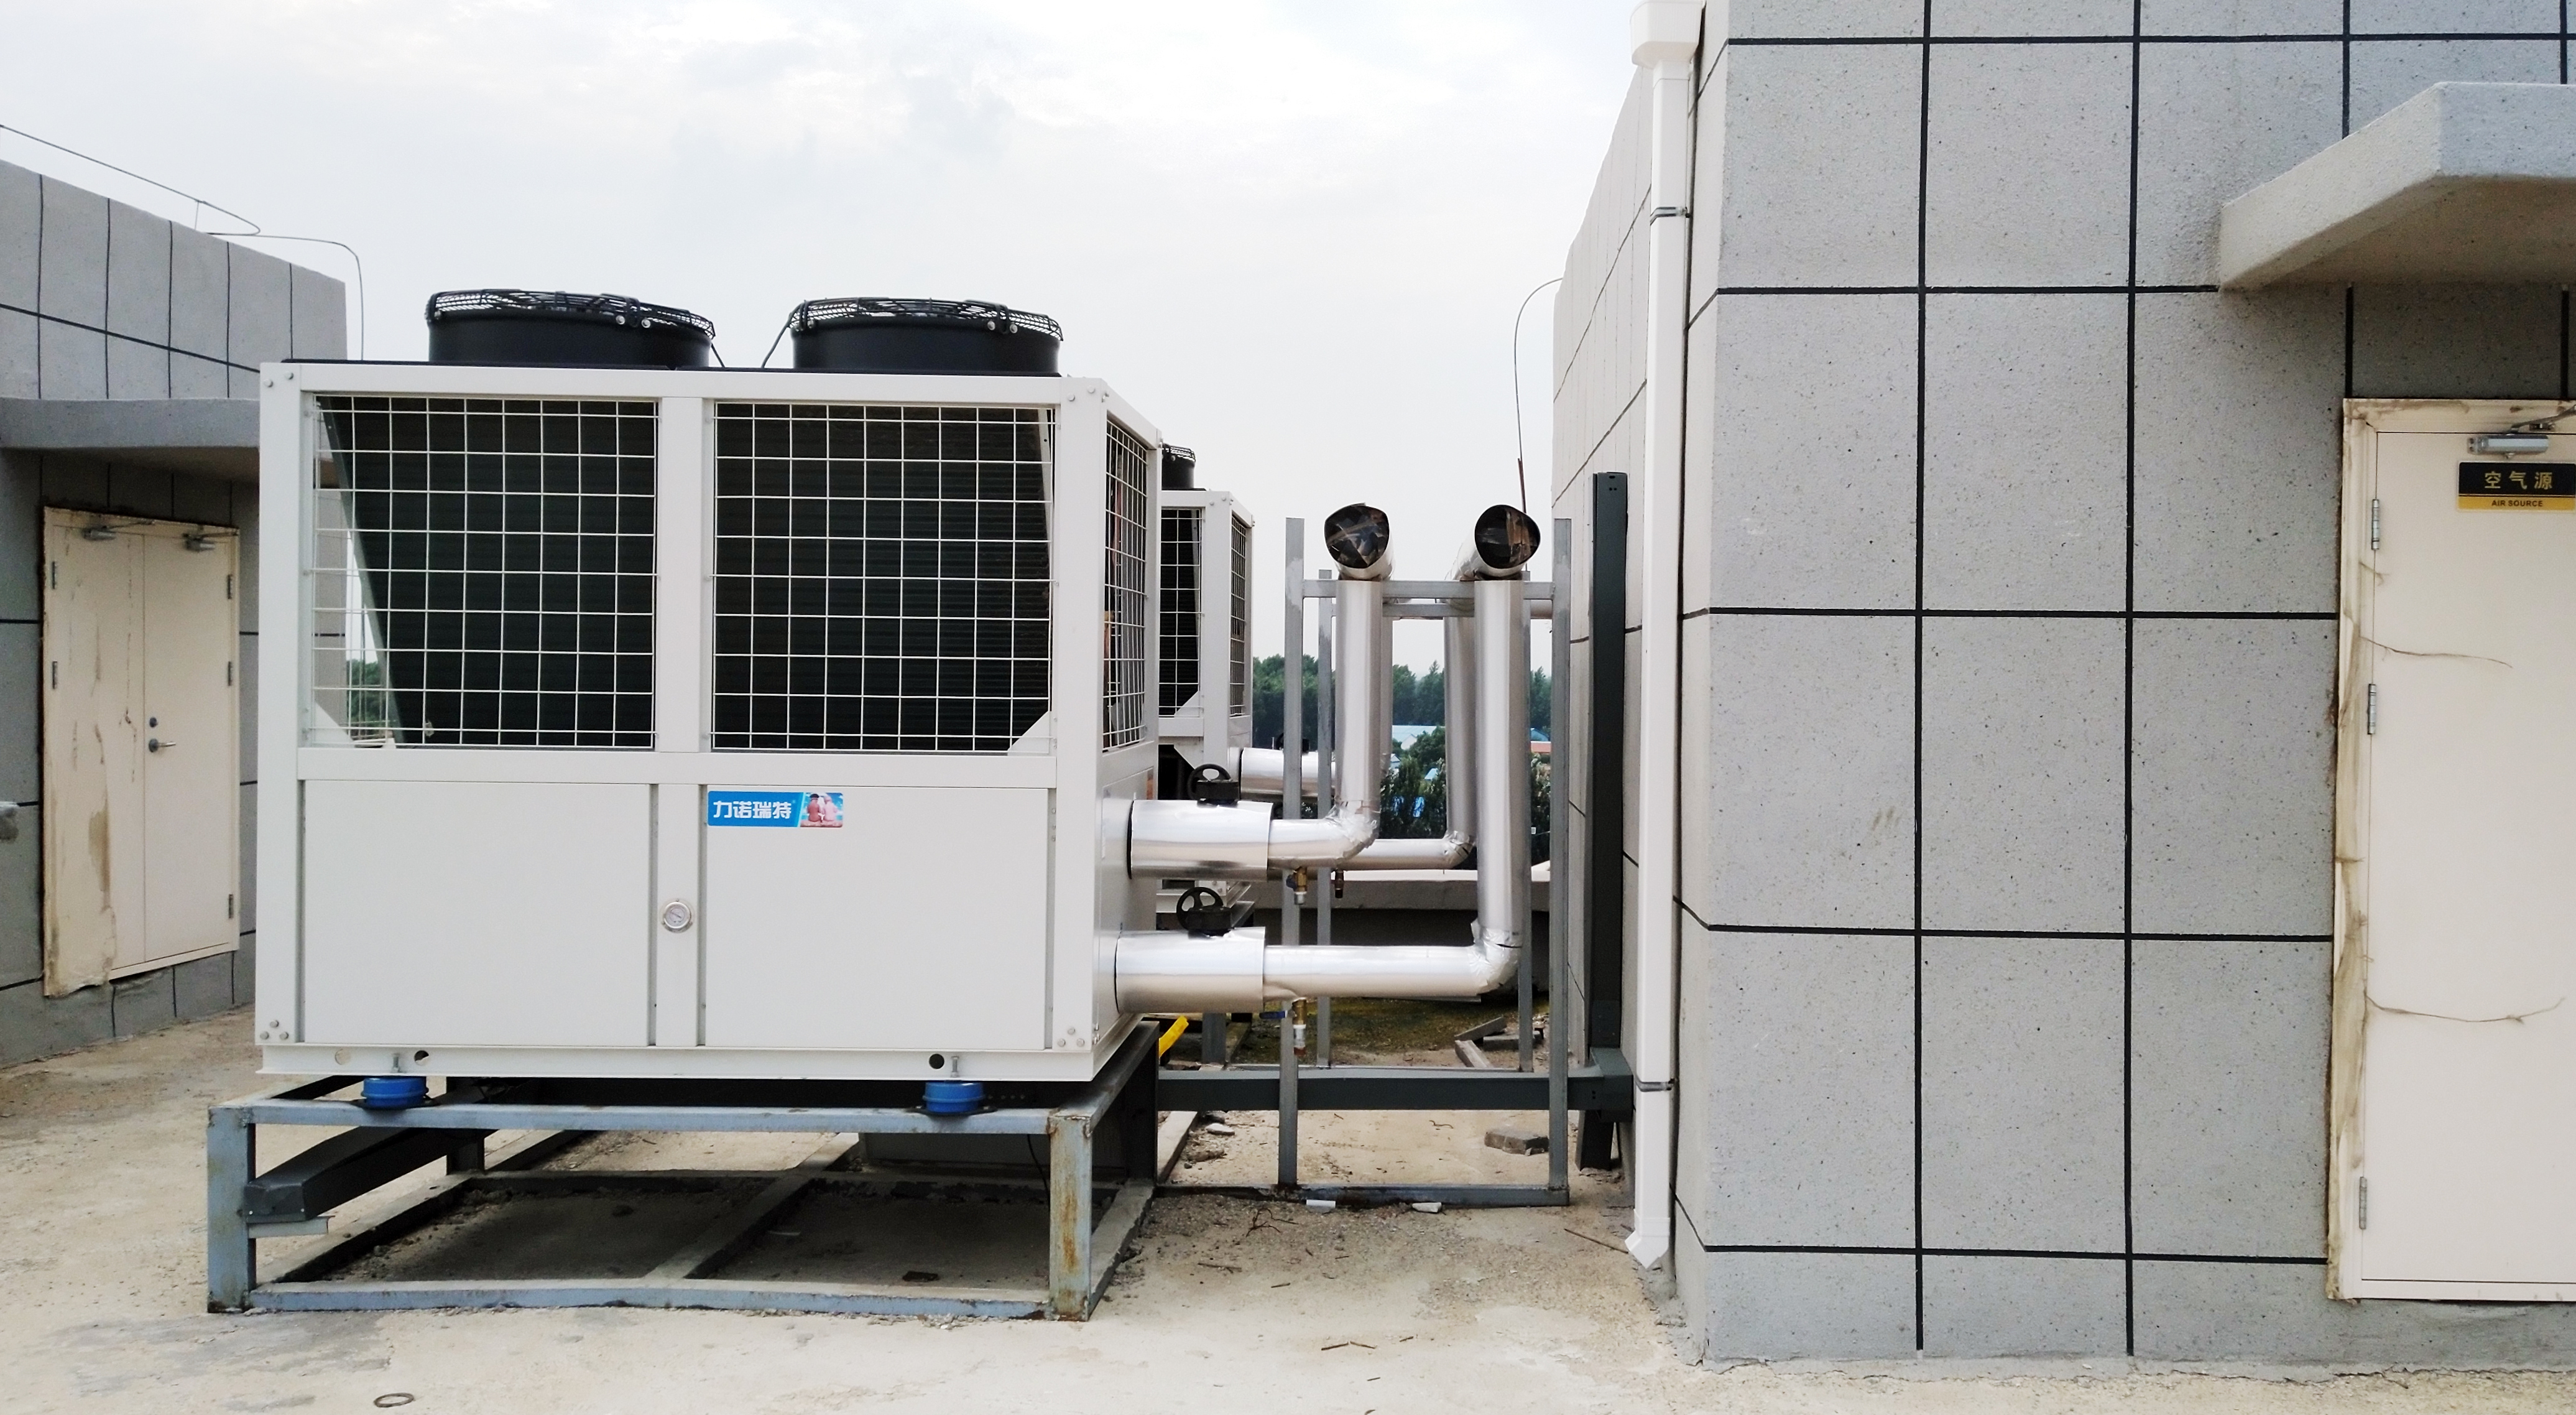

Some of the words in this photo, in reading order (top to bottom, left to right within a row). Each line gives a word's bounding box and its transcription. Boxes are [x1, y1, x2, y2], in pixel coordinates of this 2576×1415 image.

[2485, 471, 2552, 489] 空气源
[713, 800, 792, 819] 力诺瑞特
